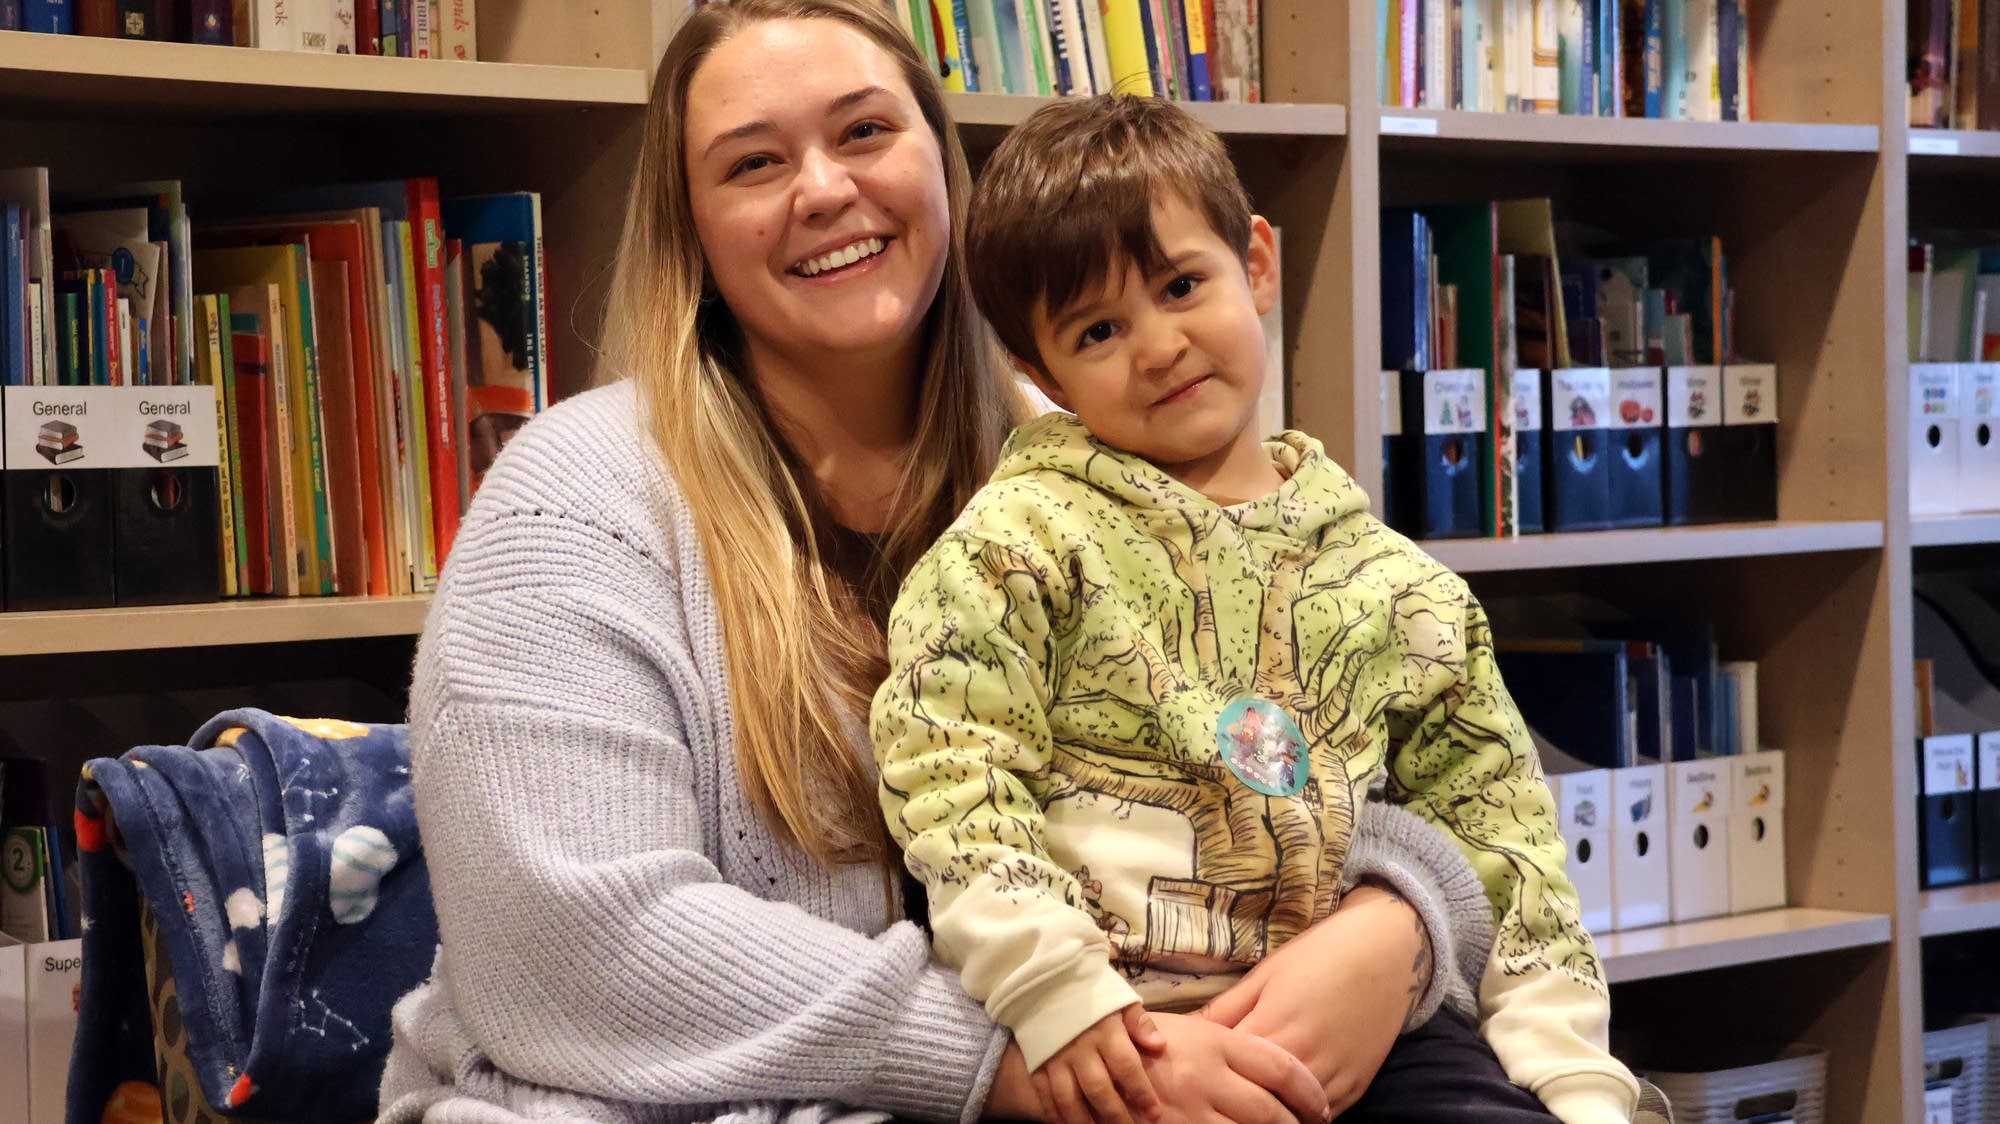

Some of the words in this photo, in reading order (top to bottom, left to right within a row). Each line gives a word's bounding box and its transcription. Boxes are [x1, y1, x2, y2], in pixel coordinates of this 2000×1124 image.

[32, 400, 87, 416] General
[139, 400, 191, 415] General
[13, 847, 24, 871] 2
